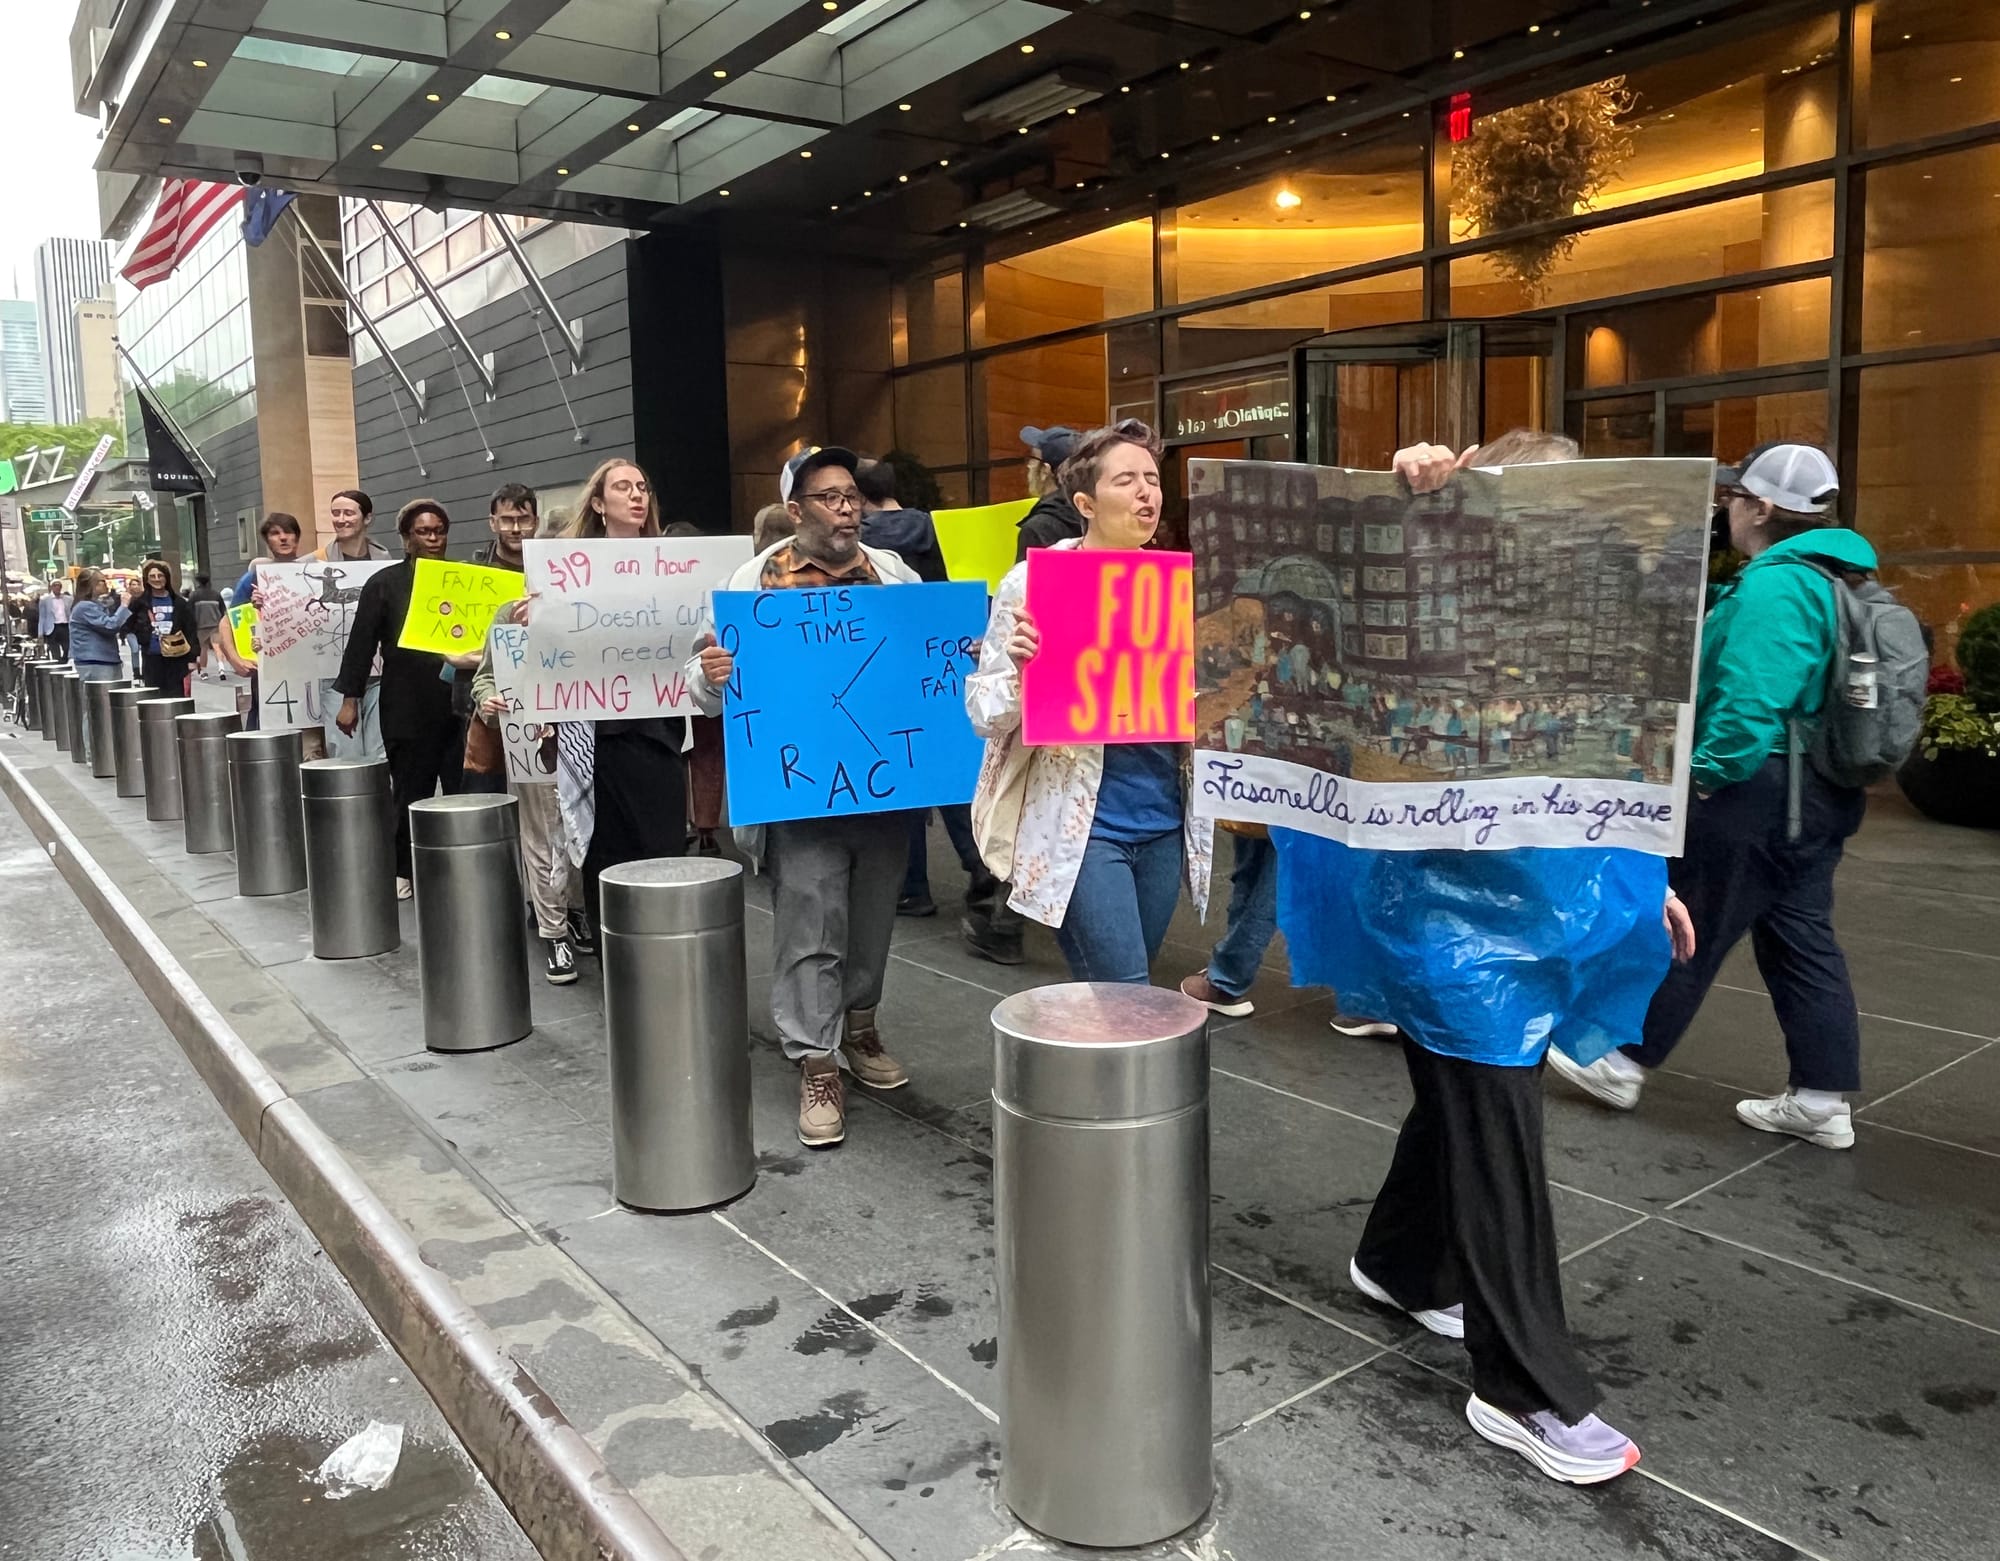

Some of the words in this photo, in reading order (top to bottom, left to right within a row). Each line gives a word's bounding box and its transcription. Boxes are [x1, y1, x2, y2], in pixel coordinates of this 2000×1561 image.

[157, 472, 199, 480] EQUINO
[442, 570, 498, 595] FAIR
[547, 551, 592, 593] $19
[614, 558, 641, 575] an
[654, 546, 700, 576] hour
[801, 589, 853, 617] IT'S
[1100, 562, 1193, 653] FOR
[796, 617, 868, 645] TIME
[602, 634, 676, 664] need
[925, 636, 973, 659] FOR
[942, 659, 960, 680] A
[921, 677, 967, 700] FAI
[1069, 649, 1195, 737] SAKE
[1203, 759, 1356, 825] Fasanella
[1362, 802, 1393, 826] is
[1397, 787, 1501, 846] rolling
[1512, 795, 1539, 815] in
[1541, 783, 1583, 816] his
[1585, 798, 1673, 842] grave
